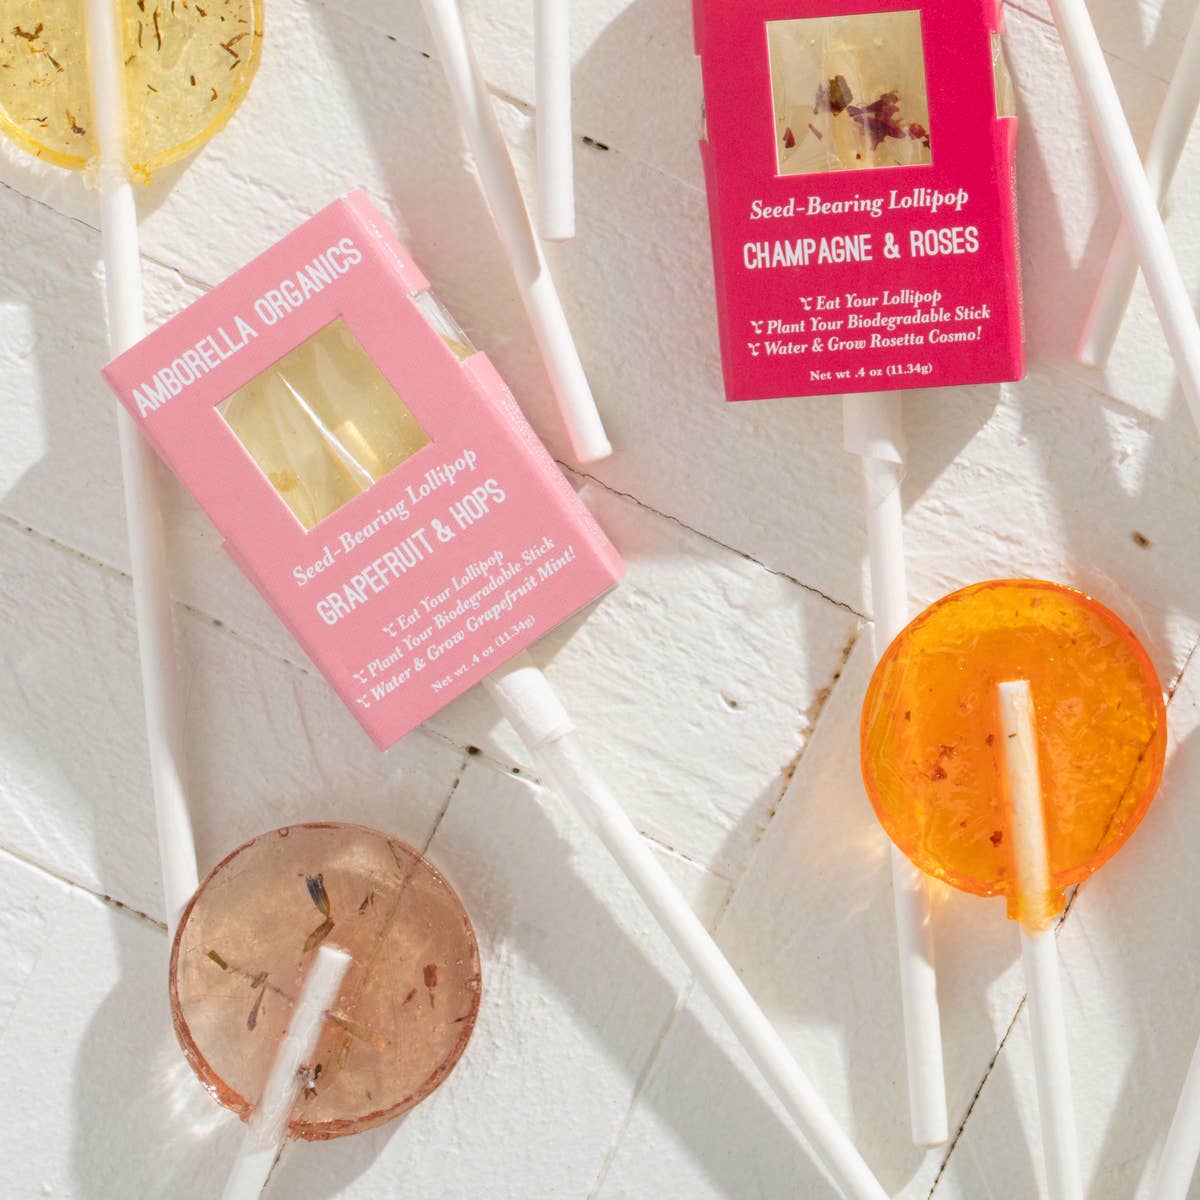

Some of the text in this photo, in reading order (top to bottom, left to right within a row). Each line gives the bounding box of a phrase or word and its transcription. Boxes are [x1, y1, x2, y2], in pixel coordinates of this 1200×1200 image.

[743, 225, 980, 270] CHAMPAGNE & ROSES
[750, 187, 969, 220] Seed-Bearing Lollipop
[131, 315, 259, 419] AMBORELLA
[253, 237, 363, 326] ORGANICS
[764, 325, 982, 356] Water & Grow Rosetta Cosmo!
[809, 362, 933, 381] Net wt .4 oz (11.34g)
[292, 499, 411, 587] Seed-Bearing
[404, 449, 477, 505] Lollipop
[316, 478, 506, 625] GRAPEFRUIT & HOPS
[369, 545, 576, 701] Water & Grow Grapefruit Mint!
